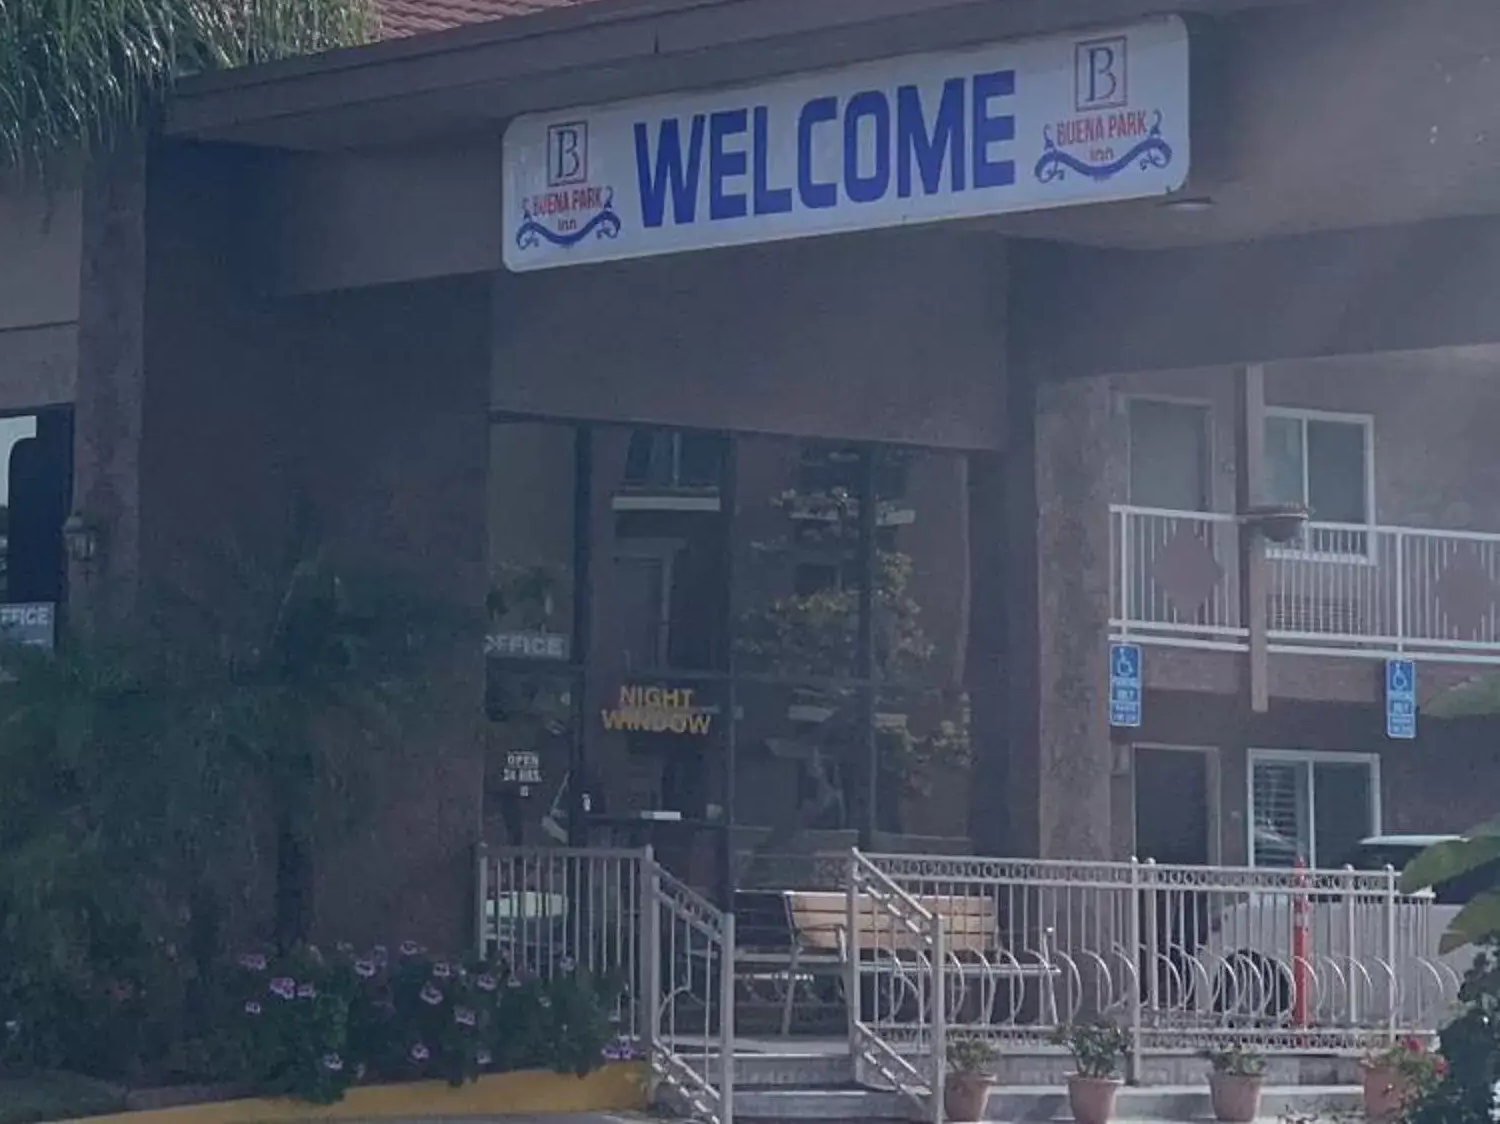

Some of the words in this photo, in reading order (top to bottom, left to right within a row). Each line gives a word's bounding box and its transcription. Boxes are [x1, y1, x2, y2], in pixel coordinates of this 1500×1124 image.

[1086, 46, 1117, 102] B
[1056, 114, 1105, 146] BUENA
[1109, 108, 1148, 138] PARK
[556, 129, 580, 178] B
[633, 69, 1016, 229] WELCOME
[532, 192, 569, 216] BUENA
[572, 187, 603, 209] PARK
[620, 684, 695, 709] NIGHT
[601, 709, 712, 735] WINDOW
[507, 754, 539, 767] OPEN
